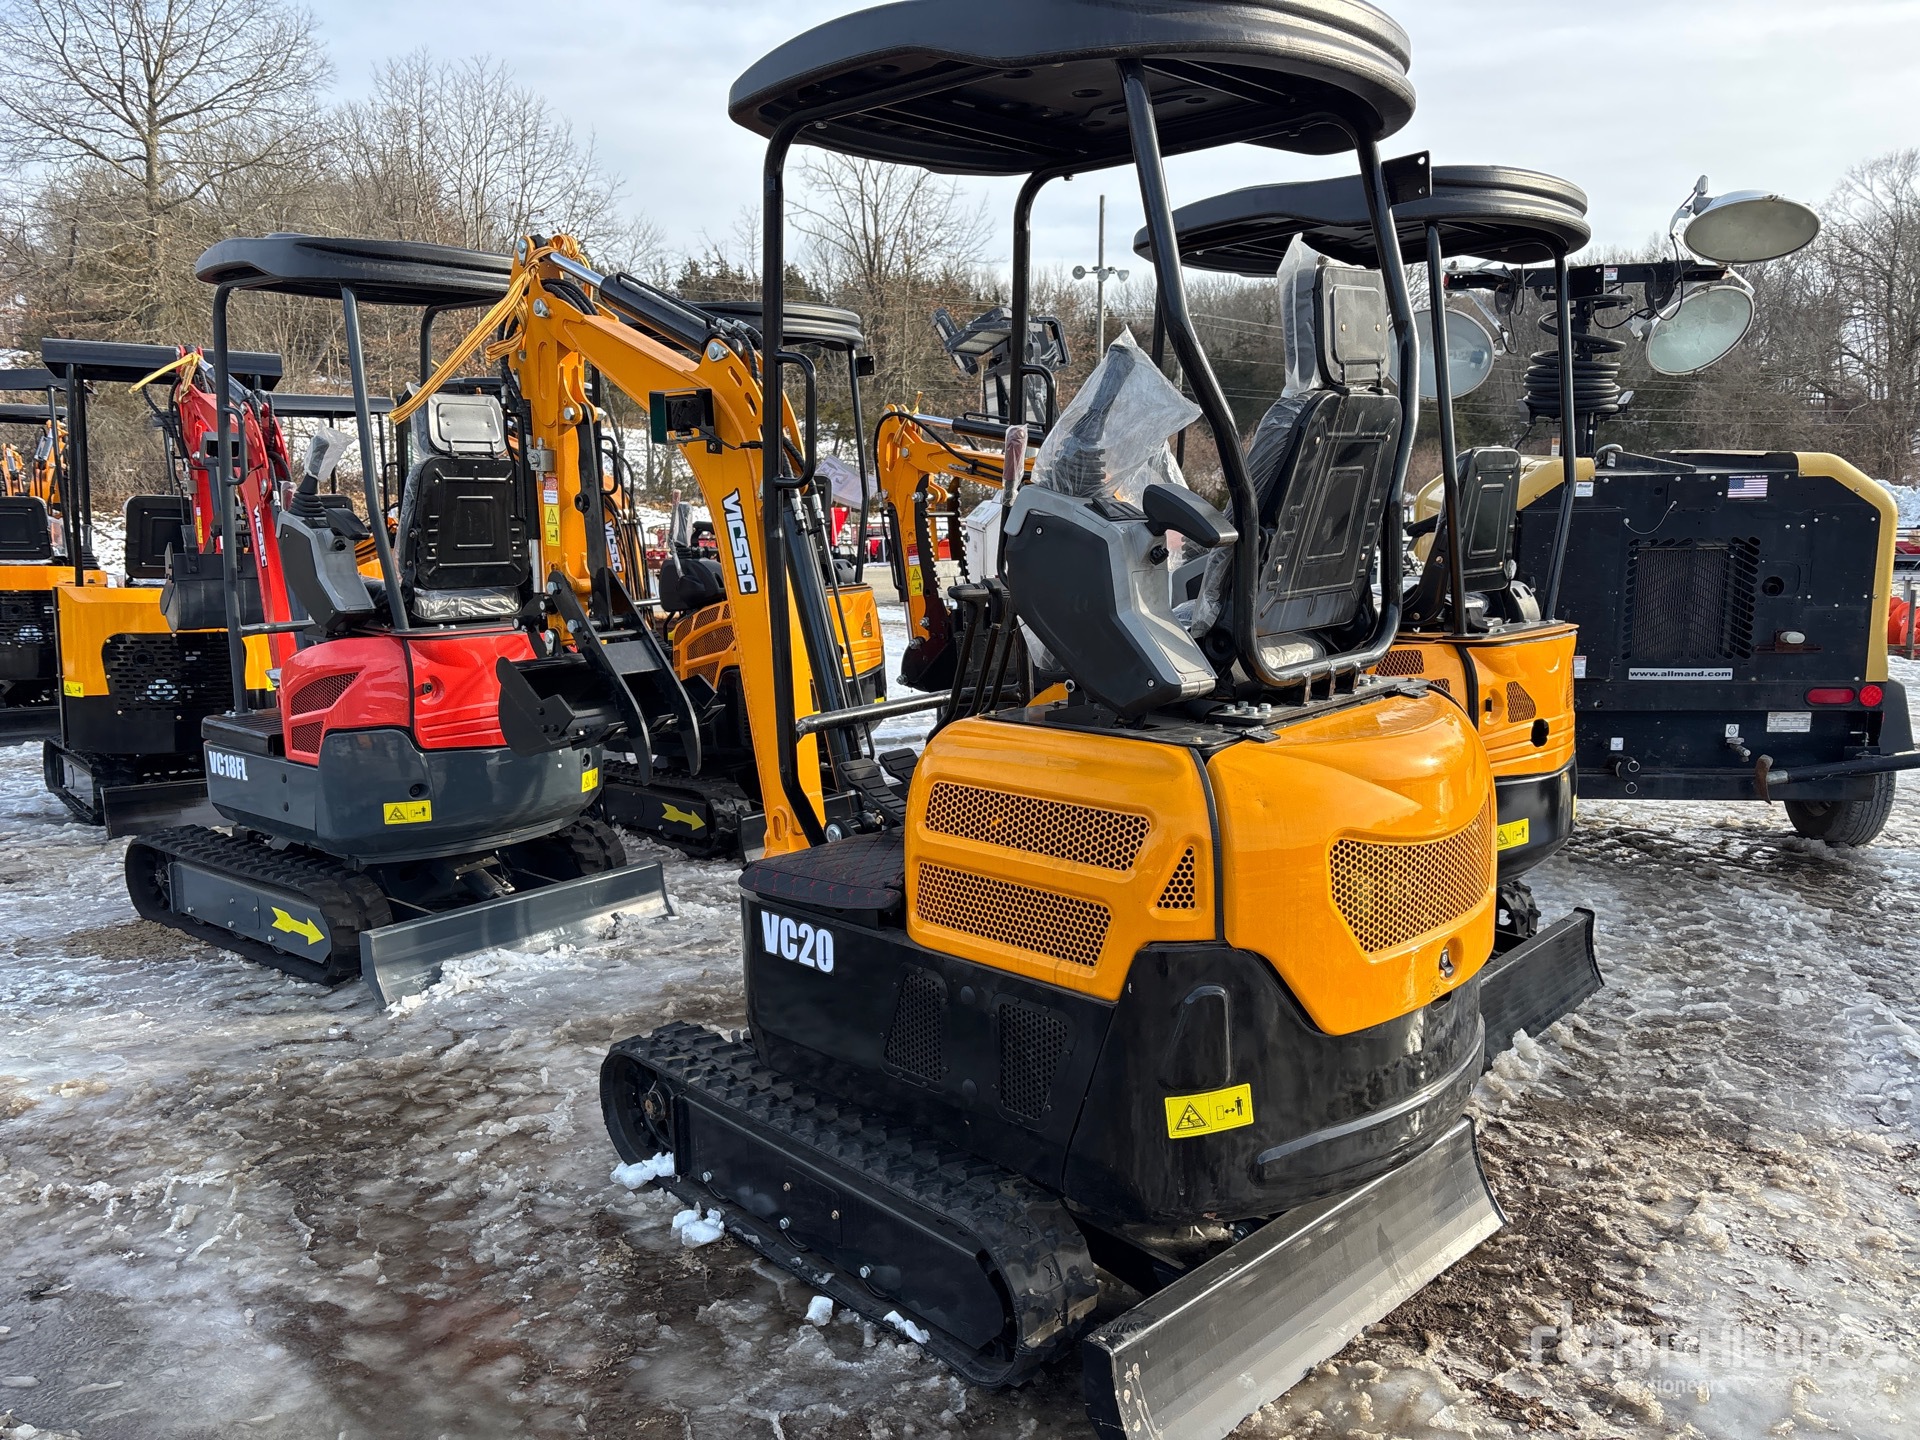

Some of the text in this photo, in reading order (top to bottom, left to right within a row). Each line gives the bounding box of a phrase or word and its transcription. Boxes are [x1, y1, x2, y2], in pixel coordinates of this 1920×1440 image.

[721, 488, 758, 594] VICSEC
[1629, 670, 1732, 678] www.allmand.com
[208, 750, 248, 781] VC18FL
[760, 910, 834, 973] VC20
